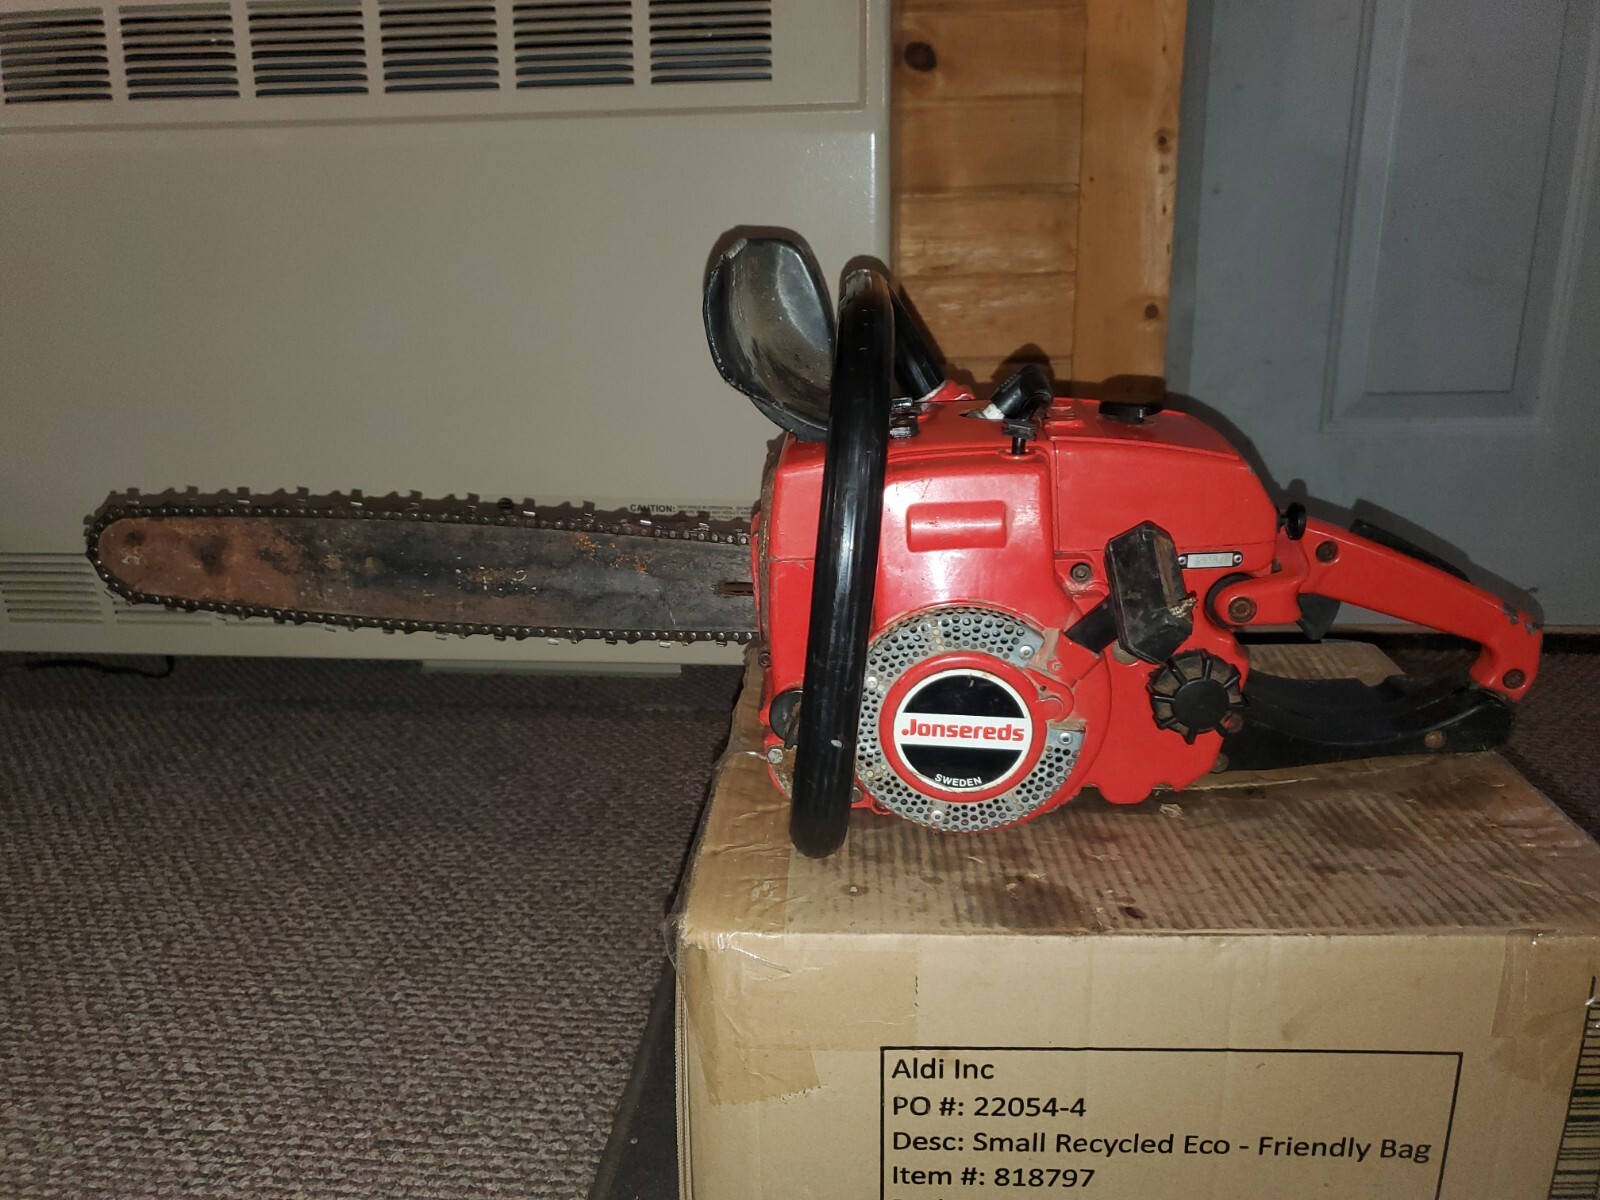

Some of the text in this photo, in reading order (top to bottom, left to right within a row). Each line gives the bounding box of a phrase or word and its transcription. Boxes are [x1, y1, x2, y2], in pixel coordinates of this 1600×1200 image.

[630, 503, 676, 512] CAUTION:
[901, 719, 1025, 742] Jonsereds
[934, 773, 983, 787] SWEDEN
[891, 1056, 995, 1080] Aldi Inc
[893, 1096, 1087, 1118] PO #: 22054-4
[893, 1131, 964, 1152] Desc:
[972, 1132, 1046, 1153] Small
[1055, 1133, 1175, 1158] Recycled
[1183, 1135, 1231, 1155] Eco
[1258, 1136, 1372, 1163] Friendly
[1379, 1138, 1432, 1164] Bag
[893, 1165, 1096, 1188] Item #: 818797
